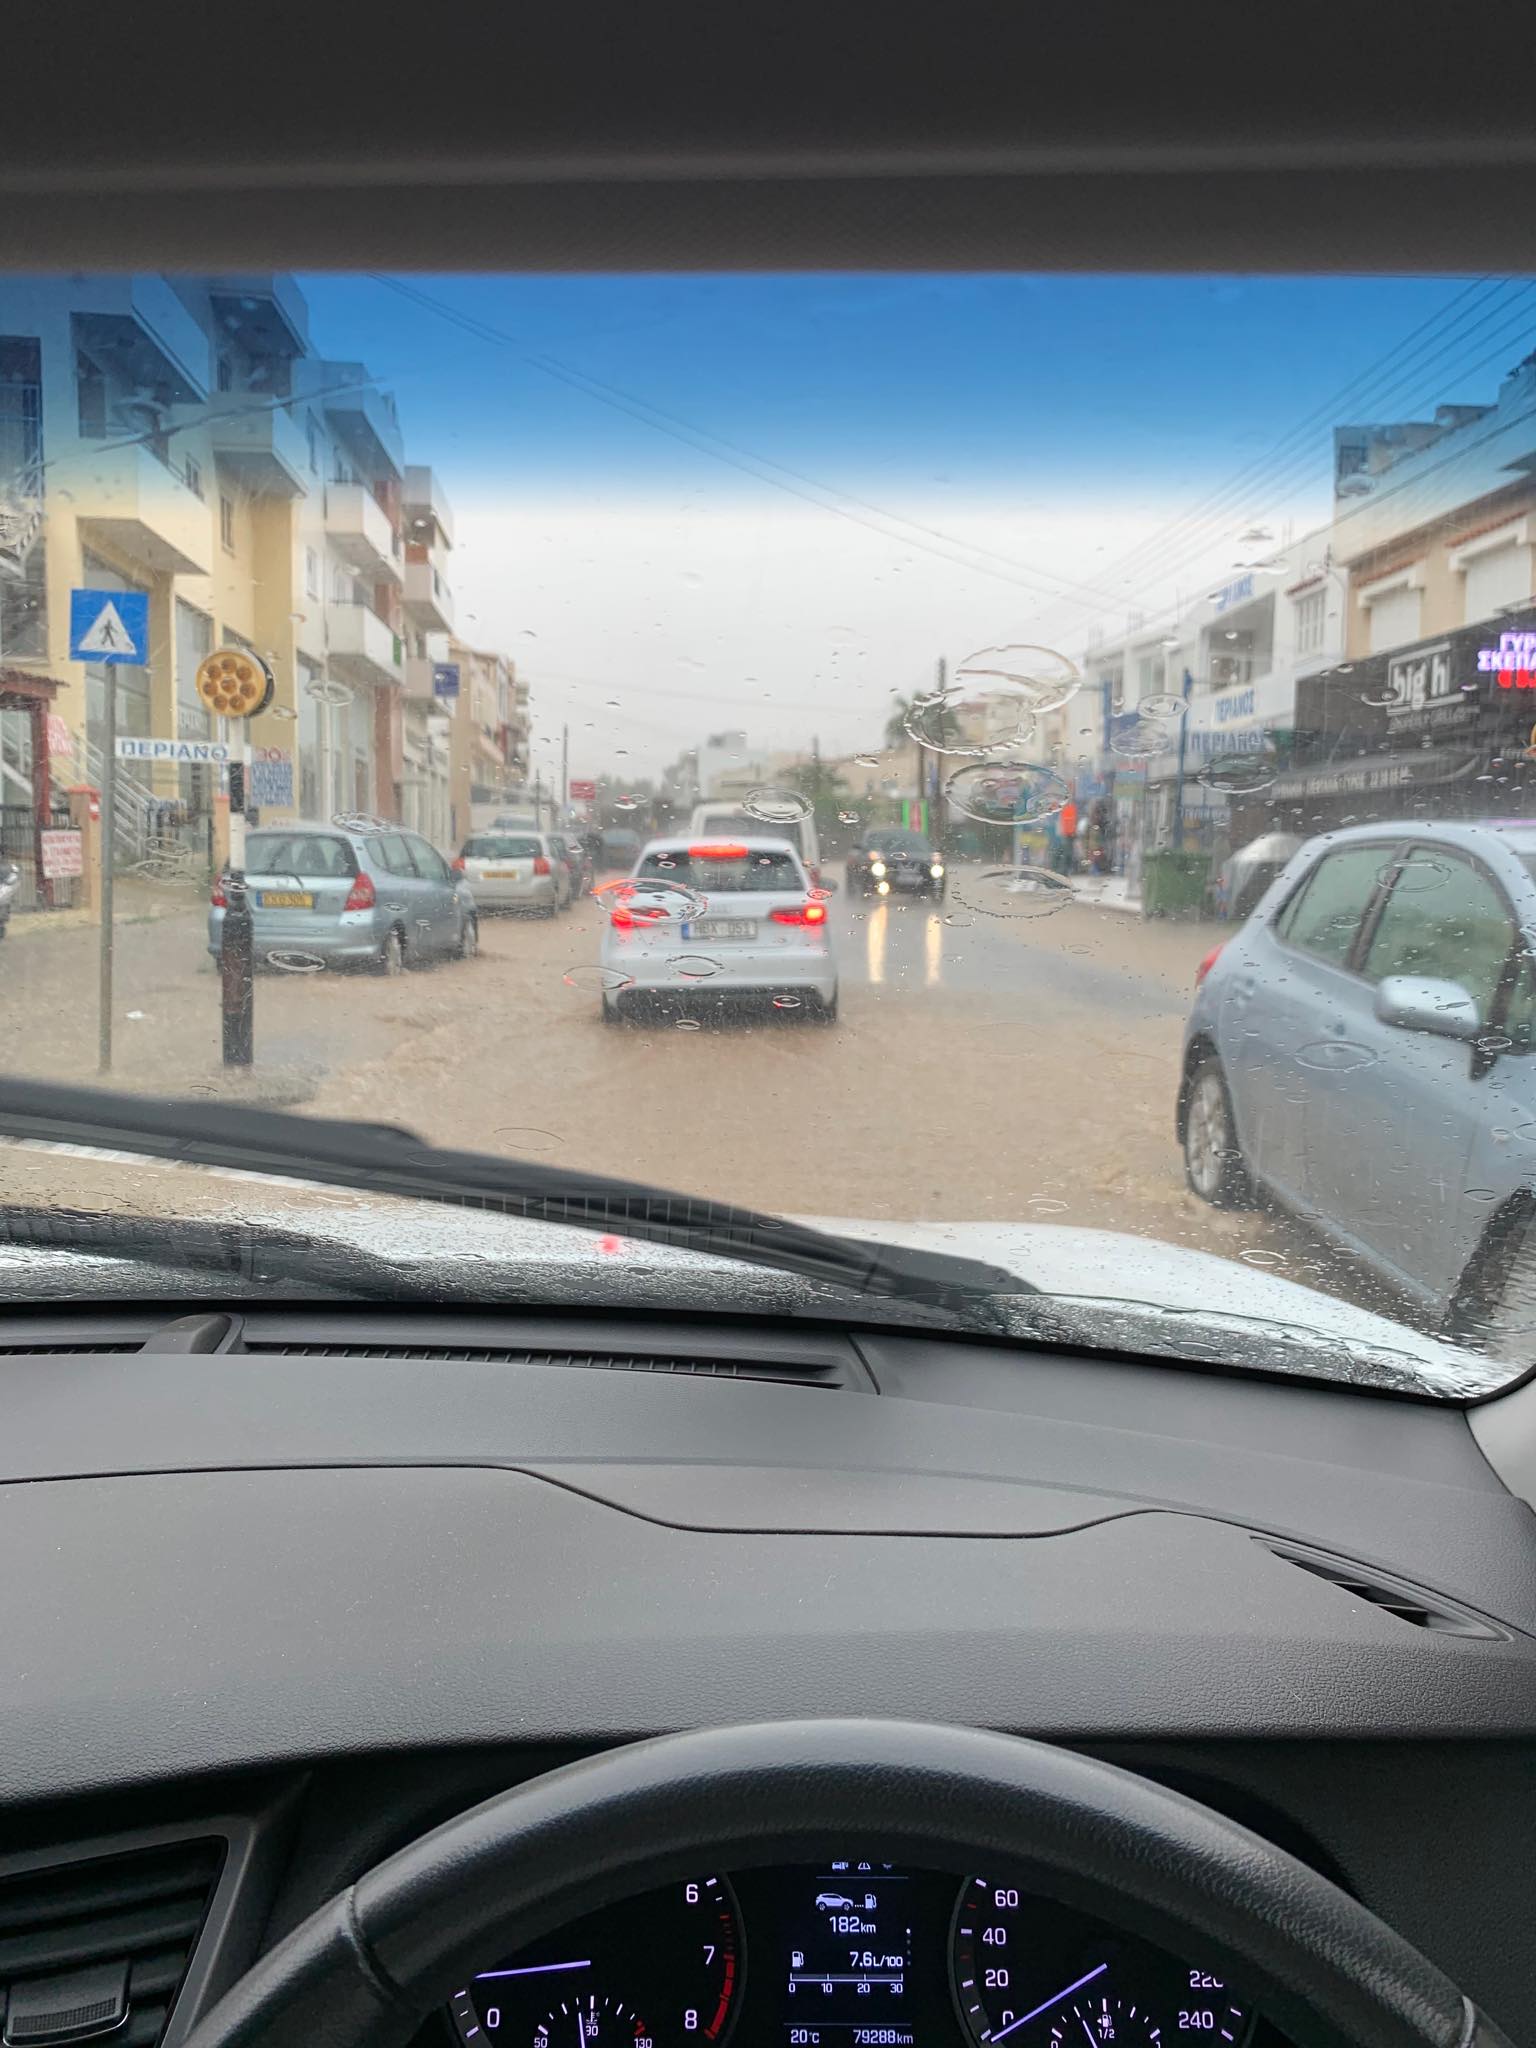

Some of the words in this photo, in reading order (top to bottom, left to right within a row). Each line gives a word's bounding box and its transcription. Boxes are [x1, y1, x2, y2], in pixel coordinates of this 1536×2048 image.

[121, 741, 227, 761] ΠΕΡΙΑΝΟ
[685, 1883, 699, 1903] 6
[994, 1889, 1019, 1907] 60
[982, 1927, 1007, 1945] 40
[703, 1945, 715, 1965] 7
[985, 1969, 1009, 1987] 20
[788, 1983, 796, 1993] 0
[821, 1983, 833, 1993] 10
[857, 1983, 870, 1993] 20
[890, 1983, 903, 1993] 30
[486, 2008, 500, 2028] 0
[684, 2010, 698, 2029] 8
[1178, 2011, 1214, 2029] 240
[1098, 2028, 1115, 2038] 1/2
[534, 2037, 548, 2048] 50
[634, 2037, 653, 2048] 130
